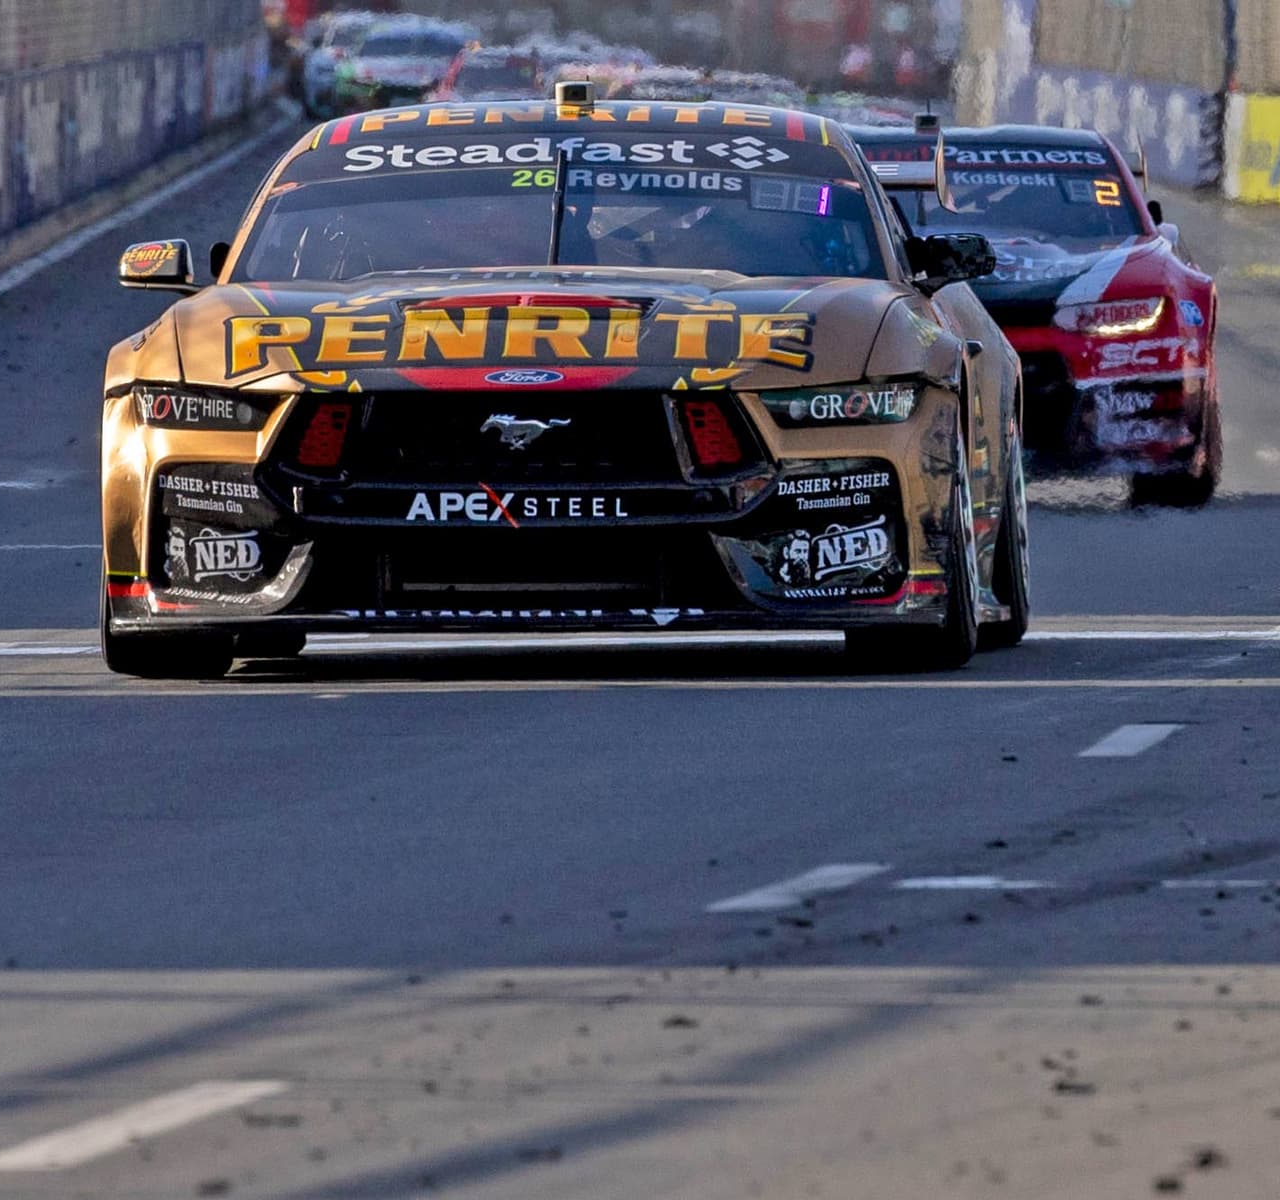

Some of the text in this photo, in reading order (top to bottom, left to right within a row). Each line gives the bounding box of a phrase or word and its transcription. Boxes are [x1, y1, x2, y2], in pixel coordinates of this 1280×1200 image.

[343, 136, 695, 173] Steadfast
[931, 145, 1106, 167] Partners
[511, 169, 743, 191] 26 Reynolds
[952, 170, 1056, 187] Kostecki
[1093, 179, 1121, 206] 2
[228, 305, 813, 379] PENRITE
[202, 399, 234, 419] HIRE
[810, 390, 897, 420] GROVE
[158, 474, 204, 493] DASHER
[212, 480, 260, 499] FISHER
[778, 477, 831, 496] DASHER
[839, 472, 890, 491] FISHER
[175, 494, 244, 514] Tasmanian Gin
[406, 482, 628, 529] APEX STEEL
[796, 492, 871, 510] Tasmanian Gin
[194, 539, 262, 571] NED
[816, 527, 889, 569] NED
